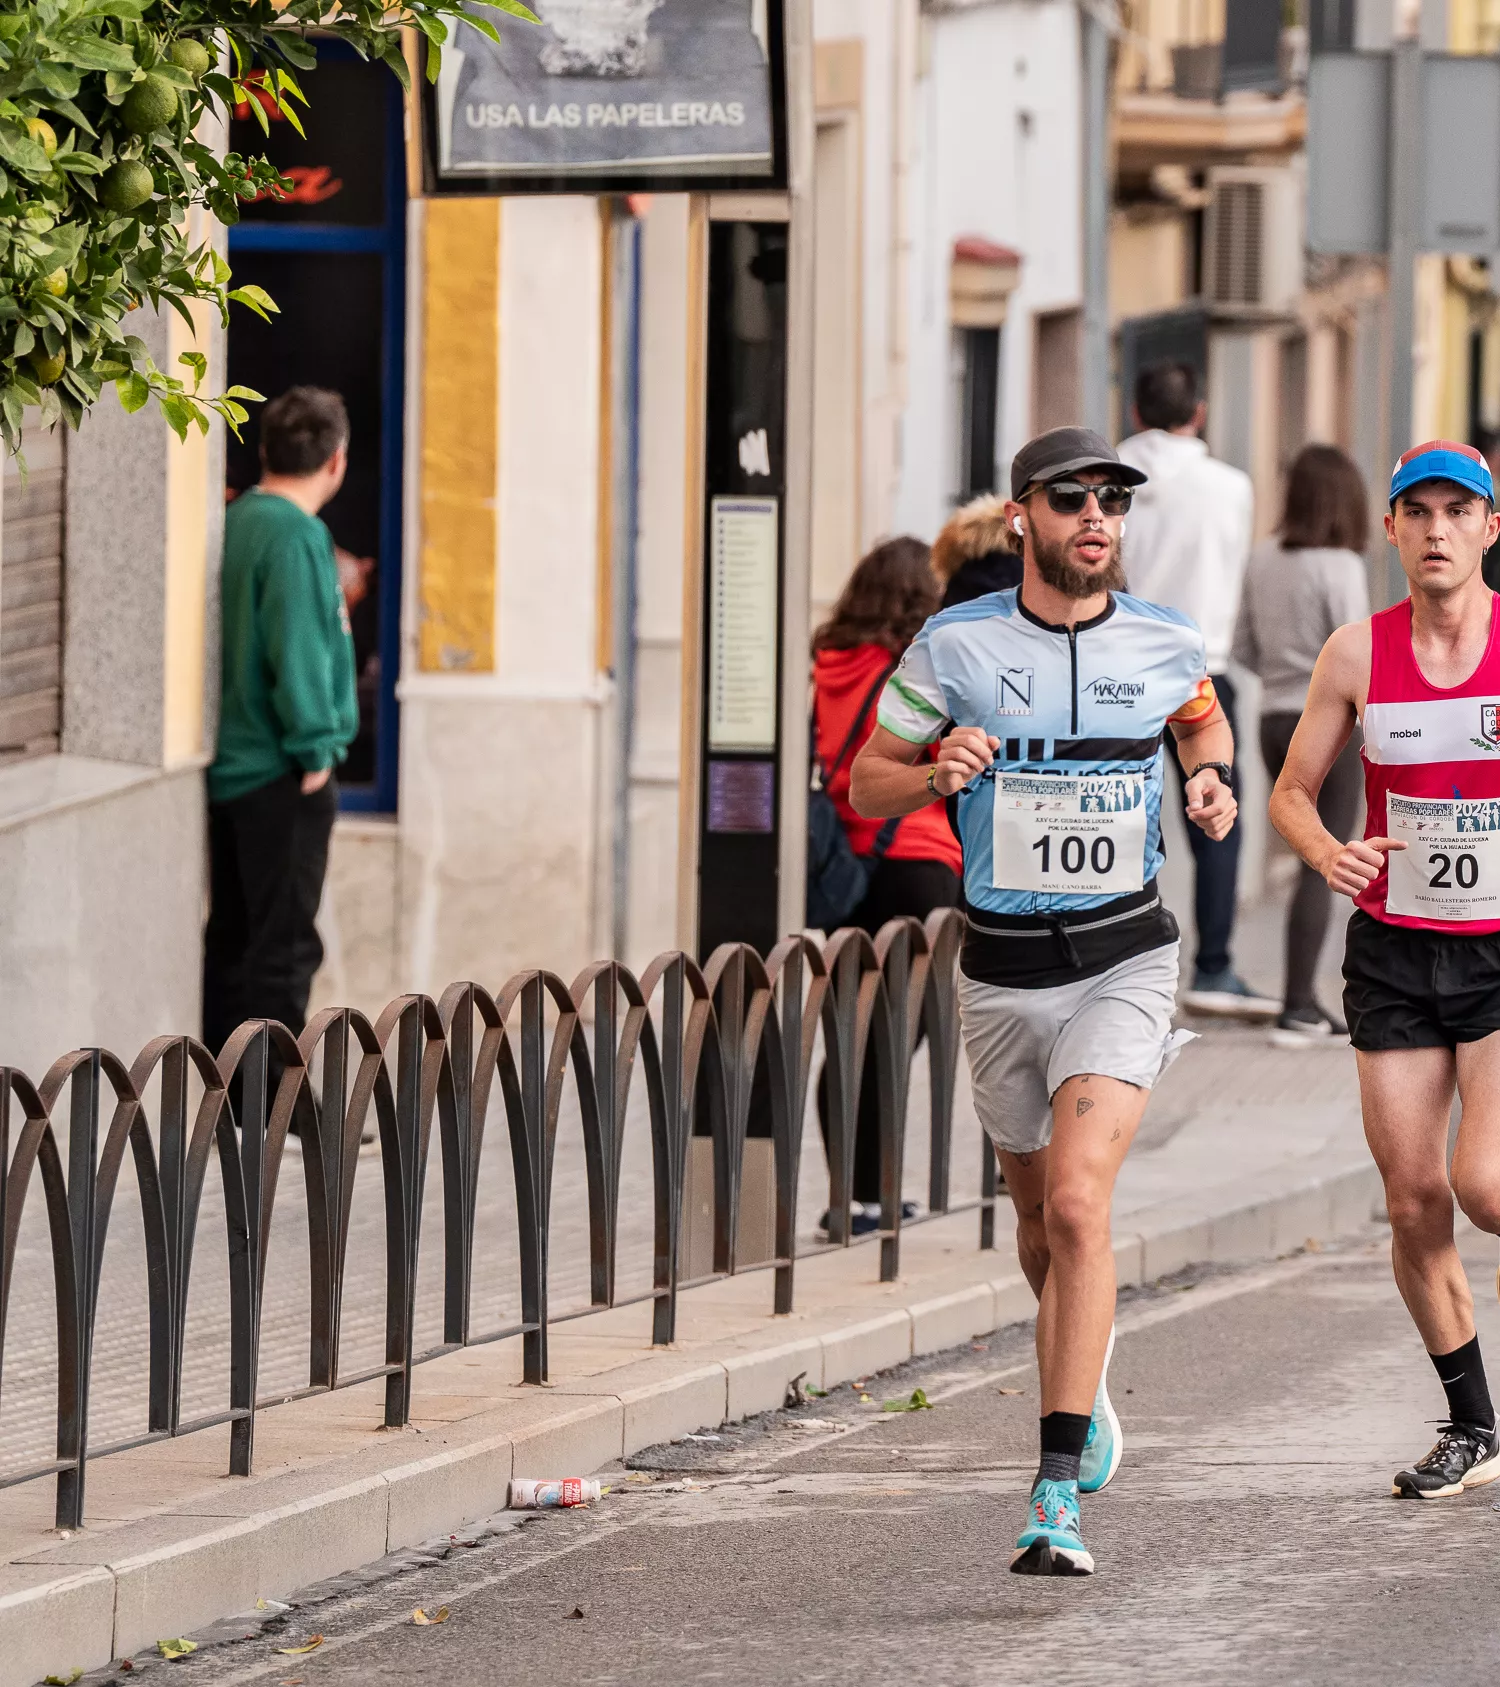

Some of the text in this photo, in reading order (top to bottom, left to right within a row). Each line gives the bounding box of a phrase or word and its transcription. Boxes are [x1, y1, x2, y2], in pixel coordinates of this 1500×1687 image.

[466, 101, 745, 128] USA LAS PAPELERAS
[997, 668, 1034, 709] Ñ
[1093, 682, 1145, 699] MARATHON
[1390, 729, 1422, 739] mobel
[1002, 778, 1030, 786] CIRCUITO
[1031, 780, 1068, 788] PROVINCIAL
[1002, 784, 1037, 793] CARRERAS
[1080, 780, 1116, 796] 2024
[1391, 798, 1411, 807] CIRCUITO
[1391, 803, 1418, 814] CARRERAS
[1455, 803, 1491, 816] 2024
[1032, 834, 1115, 874] 100
[1428, 853, 1479, 889] 20
[1472, 895, 1497, 903] ROMERO
